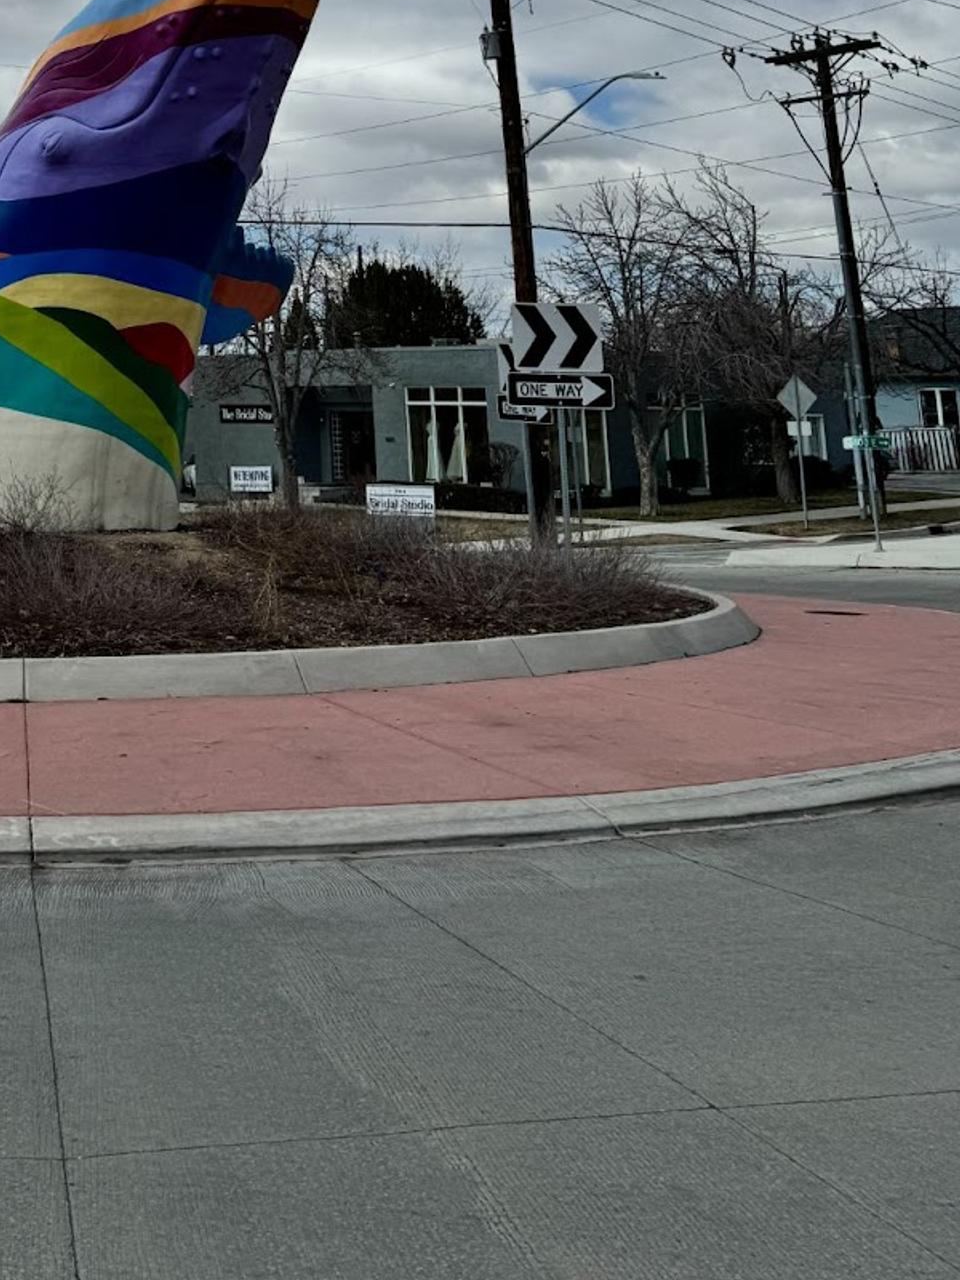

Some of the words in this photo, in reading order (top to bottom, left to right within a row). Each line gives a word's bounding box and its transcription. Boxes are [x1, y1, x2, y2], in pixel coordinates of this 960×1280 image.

[520, 383, 548, 397] ONE
[555, 383, 583, 397] WAY
[221, 407, 234, 420] The
[235, 407, 257, 421] Bridal
[369, 497, 398, 509] Bridal
[401, 498, 433, 510] Studio
